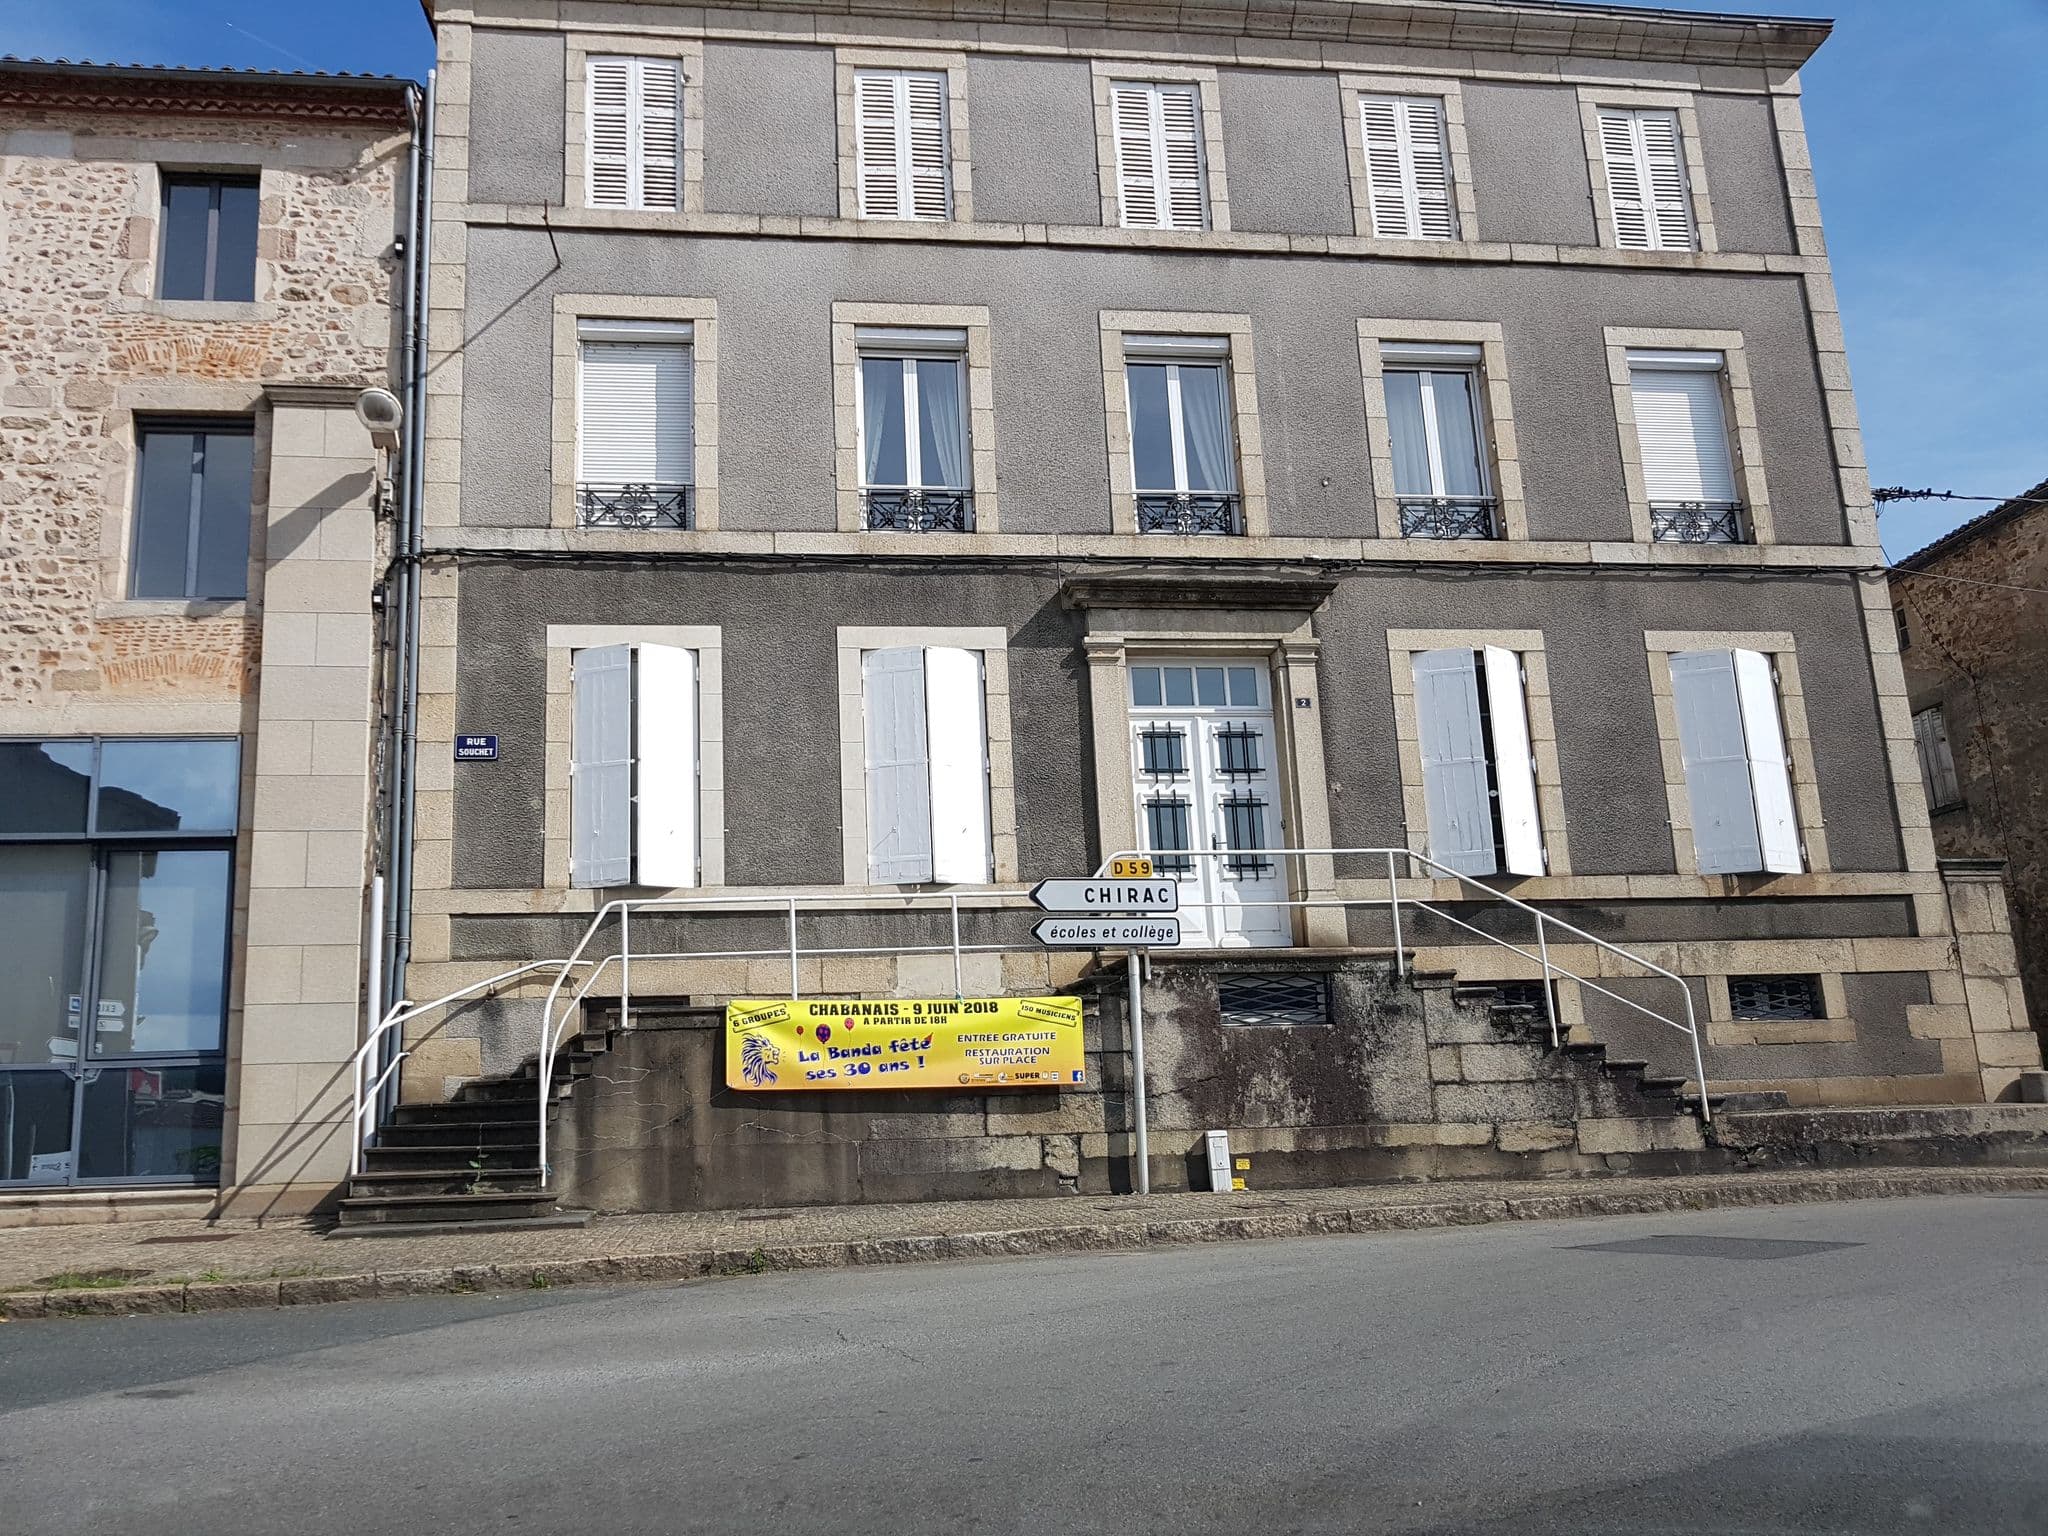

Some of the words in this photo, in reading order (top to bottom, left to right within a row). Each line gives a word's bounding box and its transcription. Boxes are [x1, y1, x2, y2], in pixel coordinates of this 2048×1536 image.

[466, 737, 487, 746] RUE
[458, 748, 494, 756] SOUCHET
[1114, 862, 1123, 874] D
[1129, 862, 1150, 874] 59
[1084, 887, 1169, 903] CHIRAC
[1050, 925, 1096, 938] écoles
[1102, 926, 1116, 938] et
[1122, 925, 1174, 942] collège
[809, 1003, 899, 1016] CHABANAIS
[912, 1003, 922, 1015] 9
[927, 1002, 959, 1015] JUIN
[964, 1001, 999, 1014] 2018
[1035, 1007, 1076, 1021] MUSICIENS
[733, 1019, 740, 1028] 6
[742, 1008, 787, 1025] GROUPES
[873, 1016, 911, 1025] PARTIR
[914, 1016, 927, 1025] DE
[930, 1015, 948, 1024] 18H
[1002, 1031, 1056, 1042] GRATUITE
[798, 1050, 820, 1063] La
[828, 1043, 882, 1060] Banda
[965, 1047, 1050, 1057] RESTAURATION
[979, 1057, 1000, 1065] SUR
[1003, 1056, 1037, 1064] PLACE
[806, 1067, 837, 1081] ses
[844, 1062, 871, 1077] 30
[879, 1061, 910, 1073] ans
[1015, 1072, 1040, 1080] SUPER
